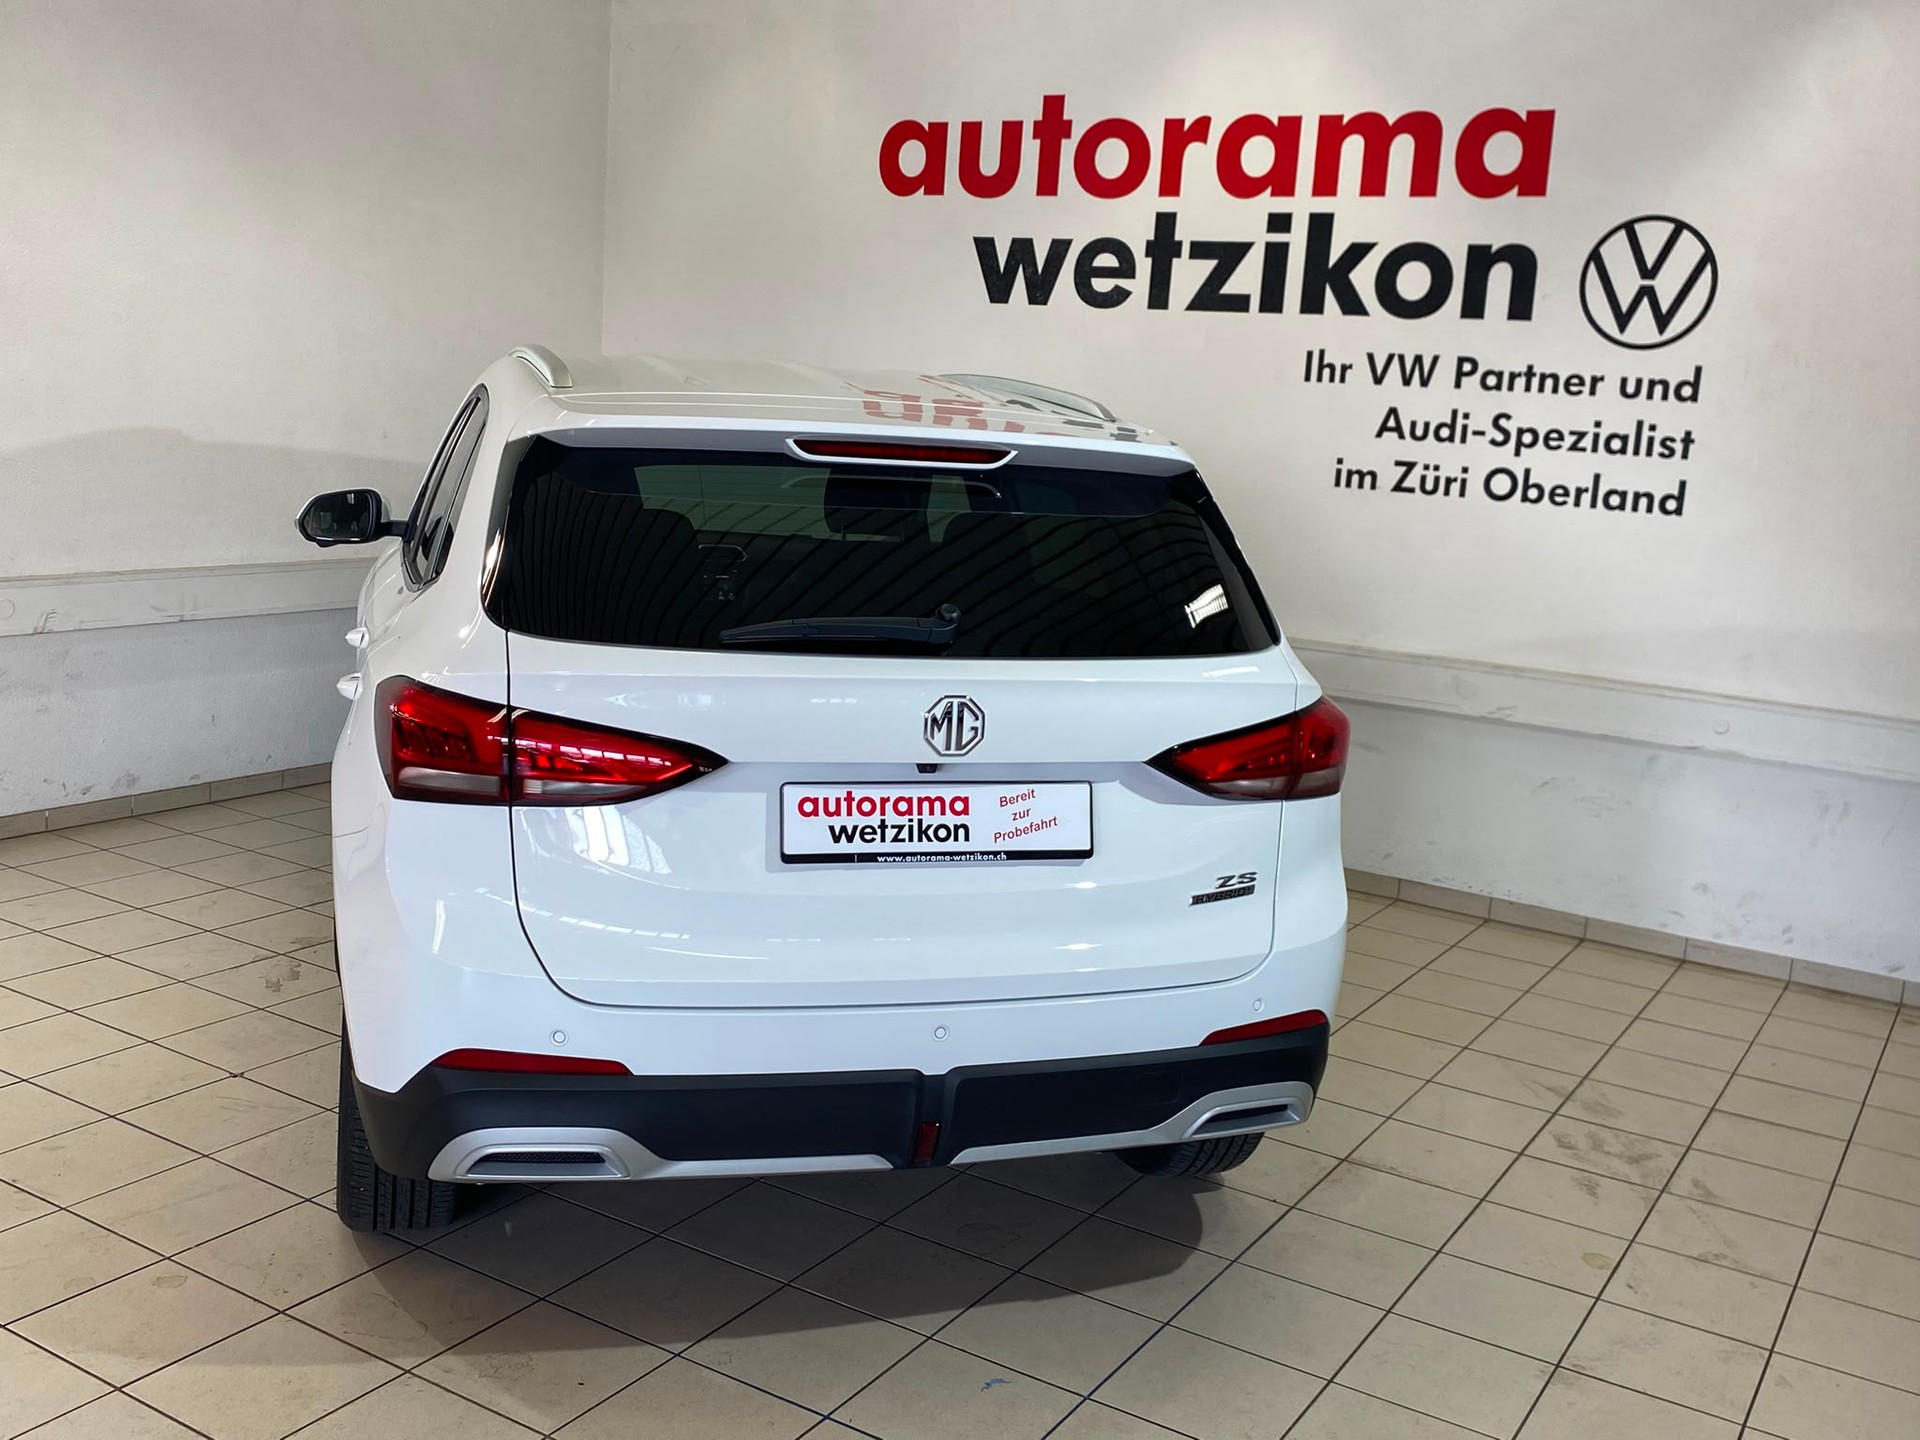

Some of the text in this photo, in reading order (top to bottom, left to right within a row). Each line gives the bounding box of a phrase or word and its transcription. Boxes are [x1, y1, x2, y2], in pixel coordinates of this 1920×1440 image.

[878, 94, 1556, 199] autorama
[972, 211, 1538, 322] wetzikon
[1304, 348, 1703, 403] Ihr VW Partner und
[1374, 406, 1695, 460] Audi-Spezialist
[1334, 457, 1687, 517] im Züri Oberland
[929, 700, 980, 752] MG
[798, 790, 970, 818] autorama
[999, 788, 1036, 808] Bereit
[1011, 807, 1031, 822] zur
[828, 818, 970, 844] wetzikon
[993, 816, 1058, 844] Probefahrt
[877, 851, 1007, 864] www.autorama-wetzikon.ch
[1215, 871, 1258, 889] ZS
